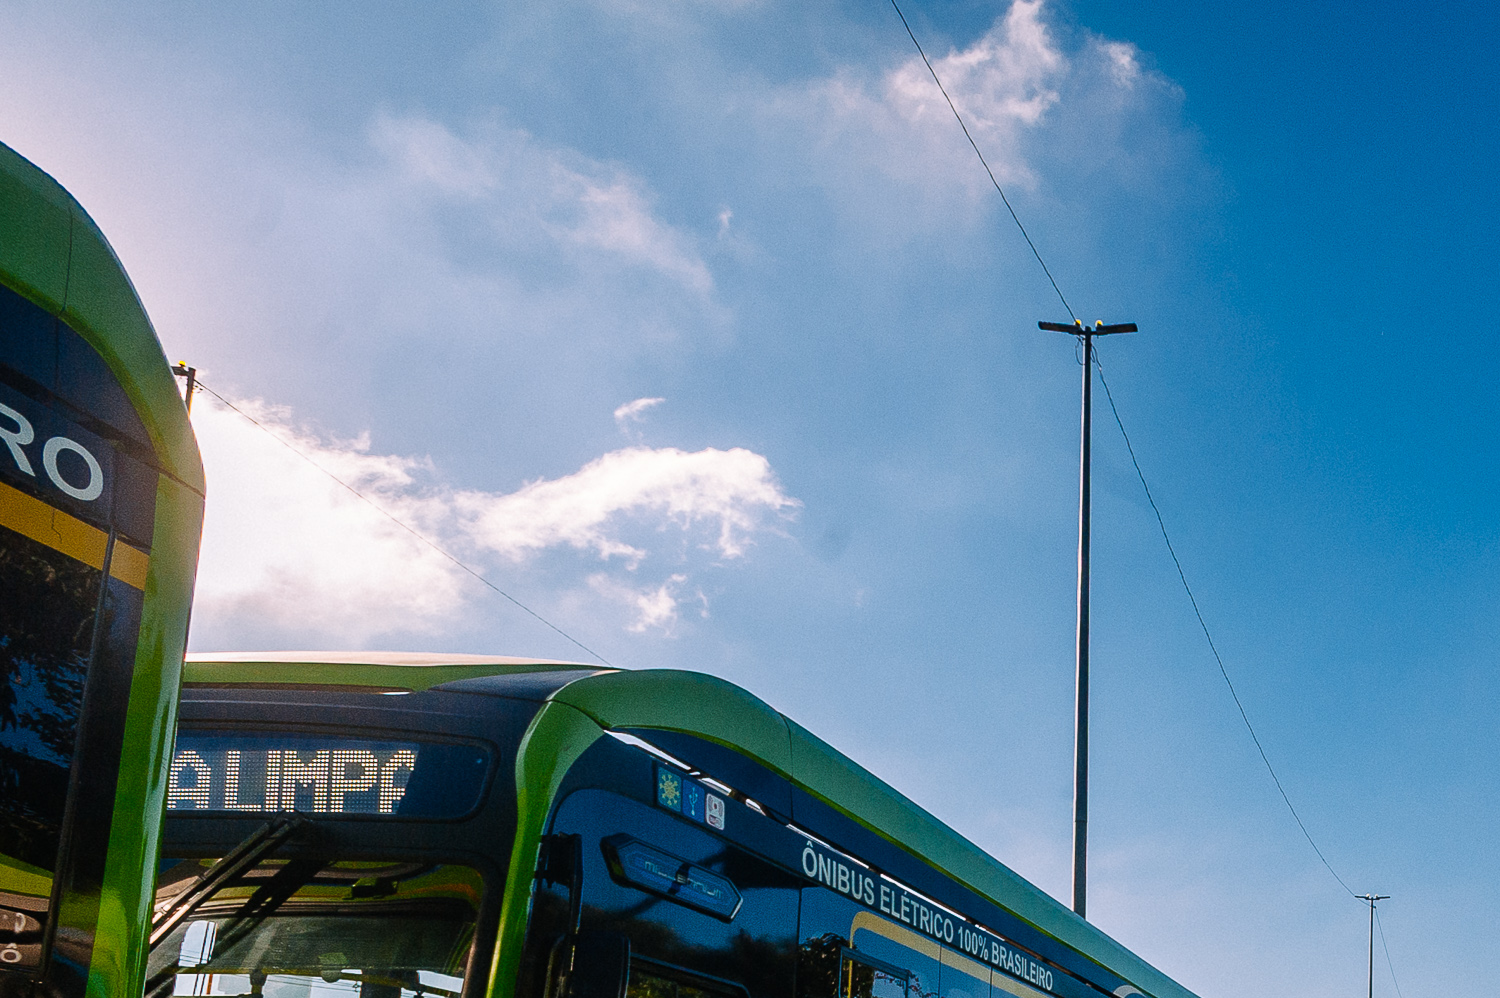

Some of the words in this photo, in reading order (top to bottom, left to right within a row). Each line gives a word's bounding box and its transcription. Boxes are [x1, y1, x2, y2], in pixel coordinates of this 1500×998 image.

[802, 840, 875, 906] ÔNIBUS
[880, 885, 954, 943] ELÉTRICO
[958, 926, 989, 960] 100%
[991, 941, 1054, 991] BRASILEIRO
